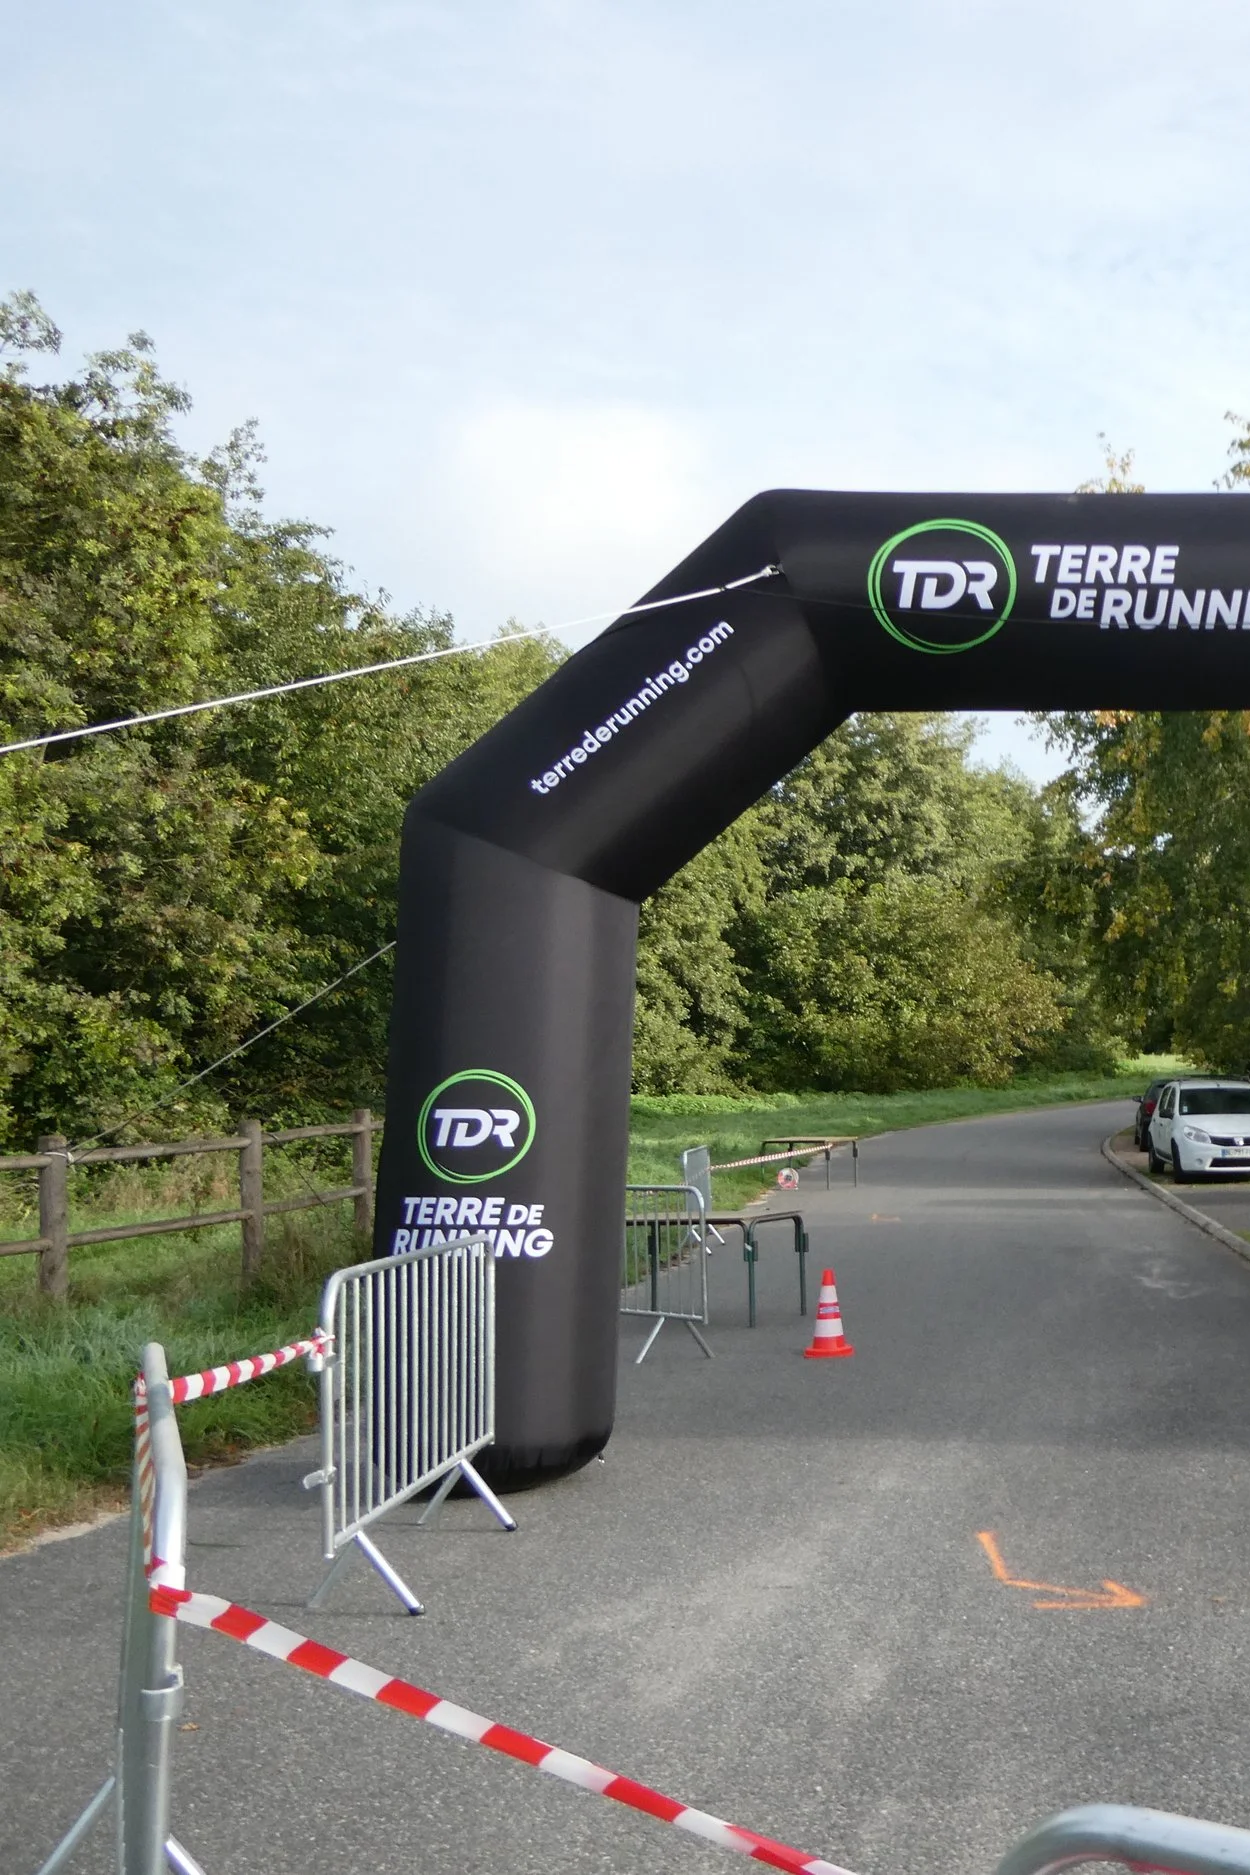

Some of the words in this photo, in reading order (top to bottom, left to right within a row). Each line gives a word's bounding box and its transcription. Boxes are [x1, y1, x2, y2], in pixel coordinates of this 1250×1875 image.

[1030, 544, 1180, 585] TERRE
[892, 560, 998, 610] TDR
[1050, 588, 1098, 619] DE
[530, 620, 736, 795] terrederunning.com
[433, 1108, 521, 1148] TDR
[404, 1196, 506, 1227] TERRE
[507, 1203, 546, 1227] DE
